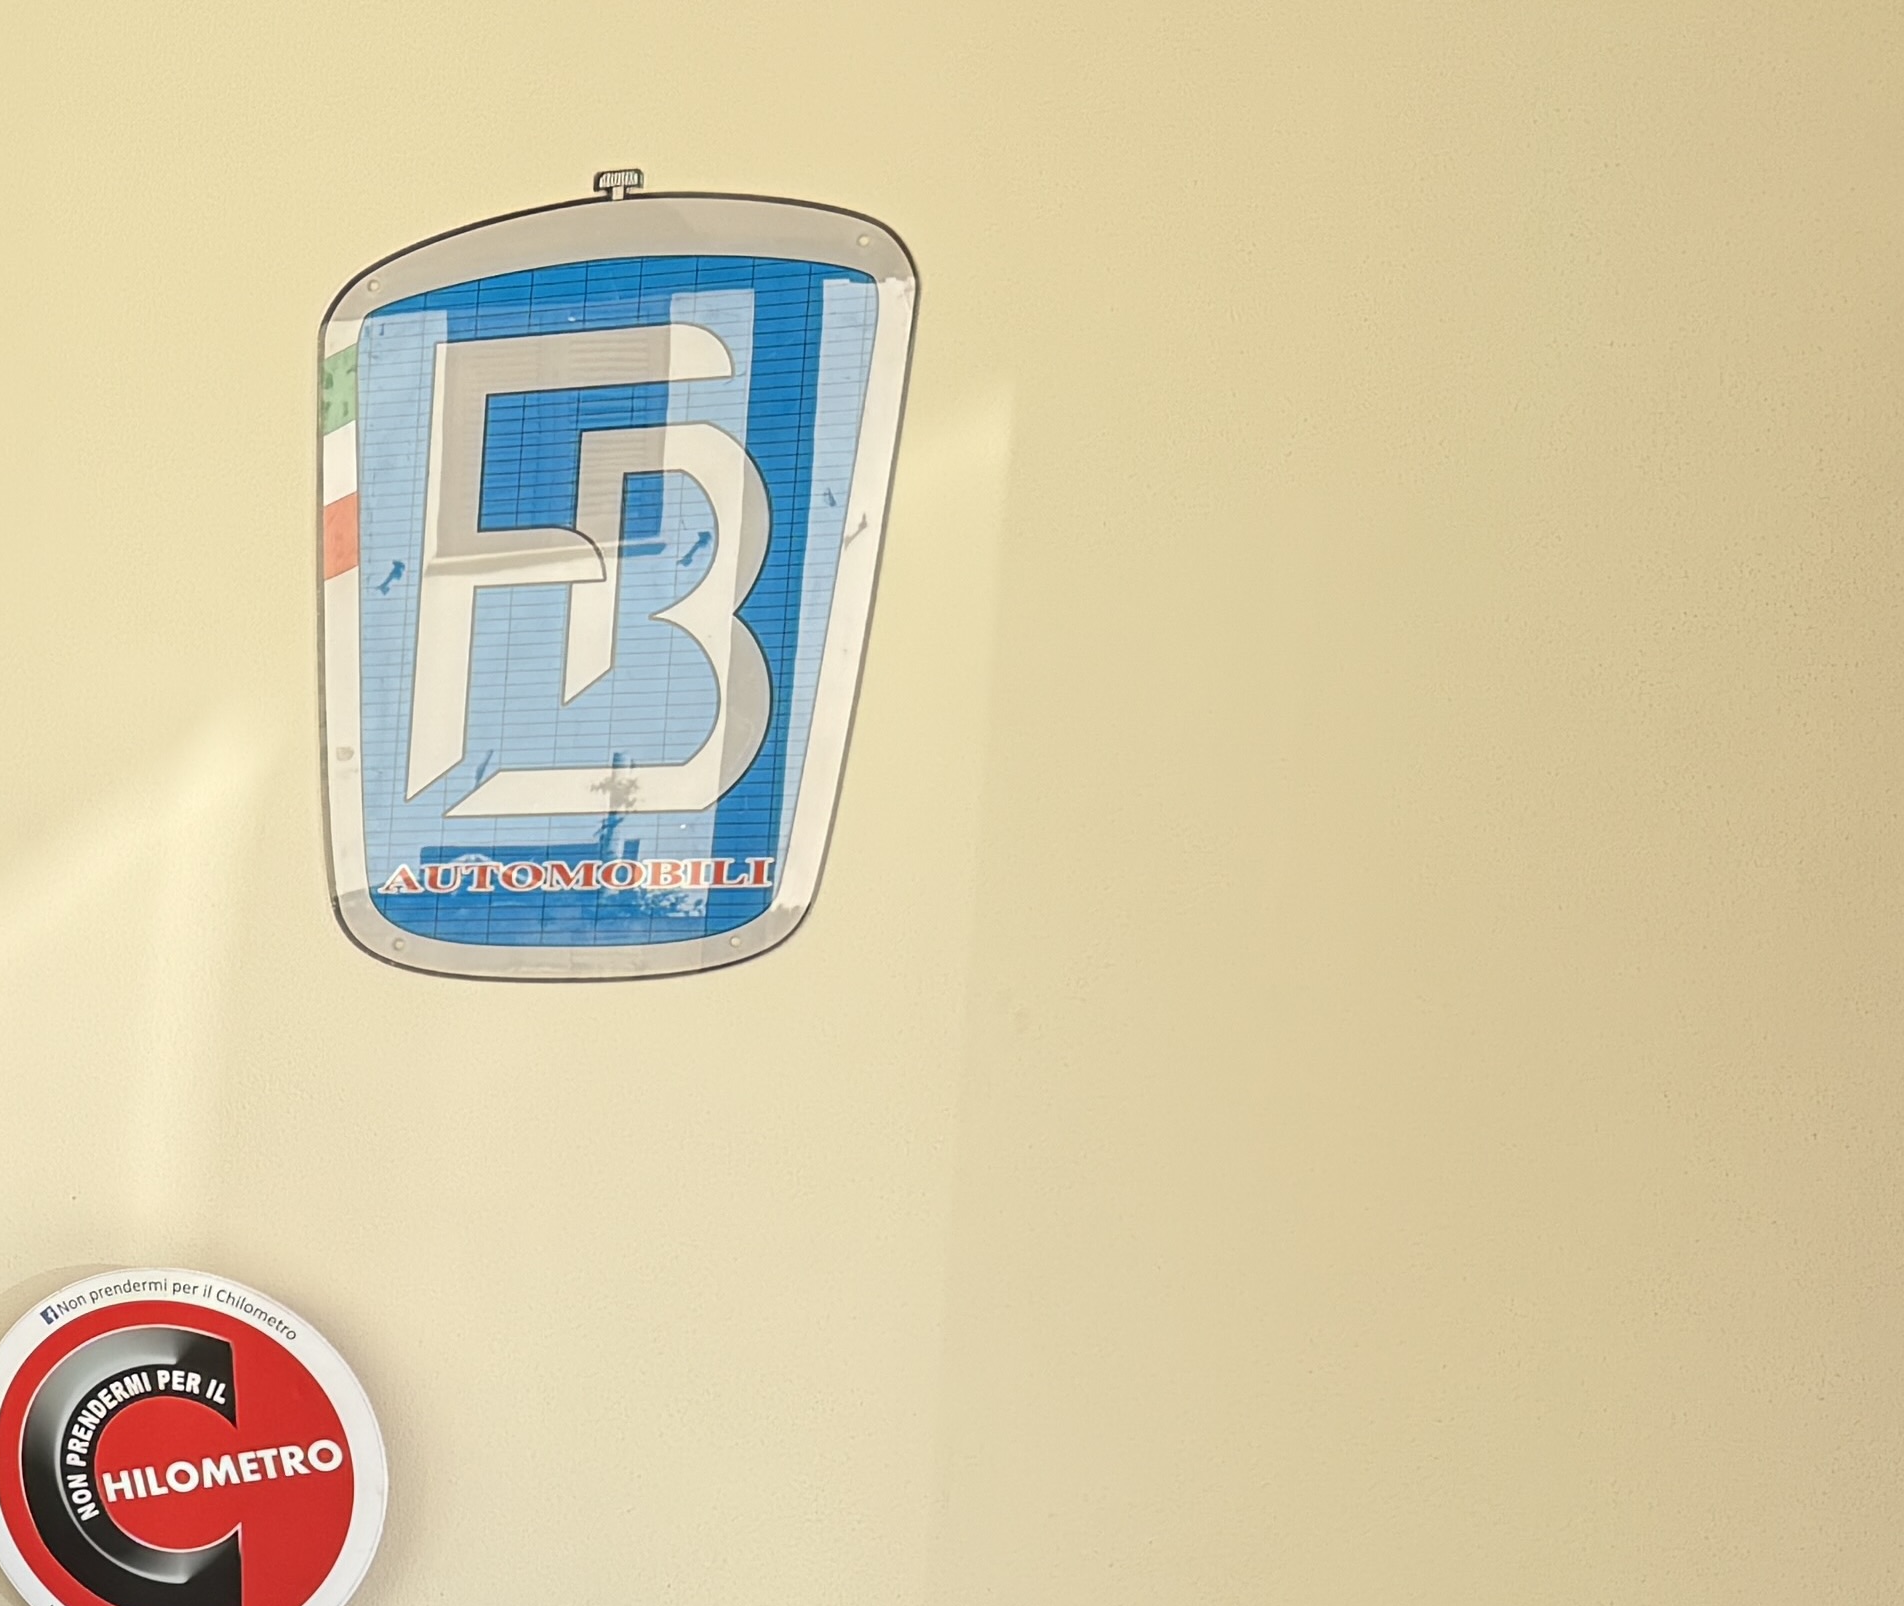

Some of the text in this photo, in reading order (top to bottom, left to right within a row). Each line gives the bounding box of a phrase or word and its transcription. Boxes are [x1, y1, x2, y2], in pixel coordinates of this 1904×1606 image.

[379, 854, 776, 895] AUTOMOBILI
[56, 1295, 87, 1316] Non
[91, 1278, 167, 1304] prendermi
[172, 1279, 197, 1295] per
[203, 1284, 212, 1298] il
[217, 1289, 297, 1341] Chilometro
[66, 1370, 226, 1522] NON PRENDERMI PER IL
